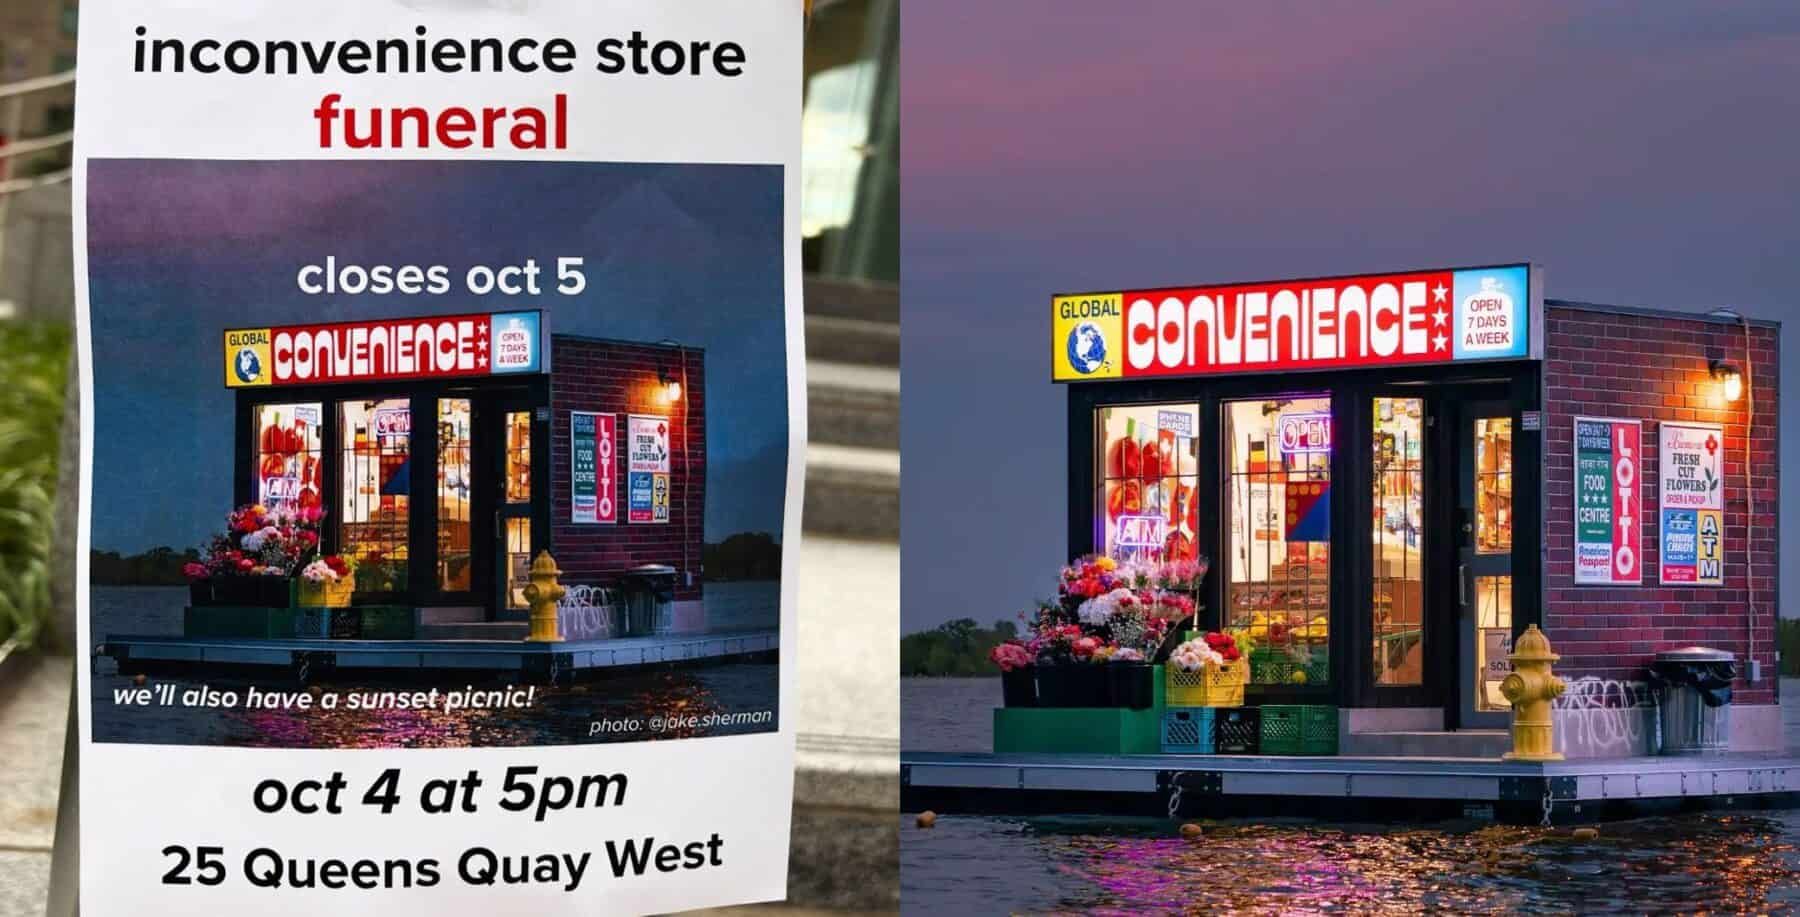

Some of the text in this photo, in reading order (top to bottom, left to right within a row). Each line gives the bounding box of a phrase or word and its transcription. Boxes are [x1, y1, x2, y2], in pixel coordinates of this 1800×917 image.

[135, 26, 746, 77] inconvenience store
[315, 94, 567, 149] funeral
[298, 256, 586, 295] closes oct 5
[1060, 299, 1120, 319] GLOBAL
[1470, 299, 1502, 312] OPEN
[1128, 282, 1427, 369] CONVENIENCE
[1468, 315, 1507, 328] 7 DAYS
[229, 332, 269, 346] GLOBAL
[274, 322, 474, 379] CONVENIENCE
[503, 332, 525, 341] OPEN
[1466, 331, 1509, 345] A WEEK
[1283, 418, 1331, 448] OPEN
[599, 418, 612, 517] LOTTO
[1672, 453, 1701, 466] FRESH
[1678, 466, 1696, 478] CUT
[1583, 475, 1606, 491] FOOD
[1665, 479, 1706, 492] FLOWERS
[1580, 508, 1610, 523] CENTRE
[1616, 428, 1634, 575] LOTTO
[1701, 515, 1719, 579] ATM
[113, 684, 535, 715] we’ll also have a sunset picnic!
[589, 709, 772, 736] photo: @jake.sherman
[254, 766, 628, 822] oct 4 at 5pm
[162, 834, 724, 892] 25 Queens Quay West
